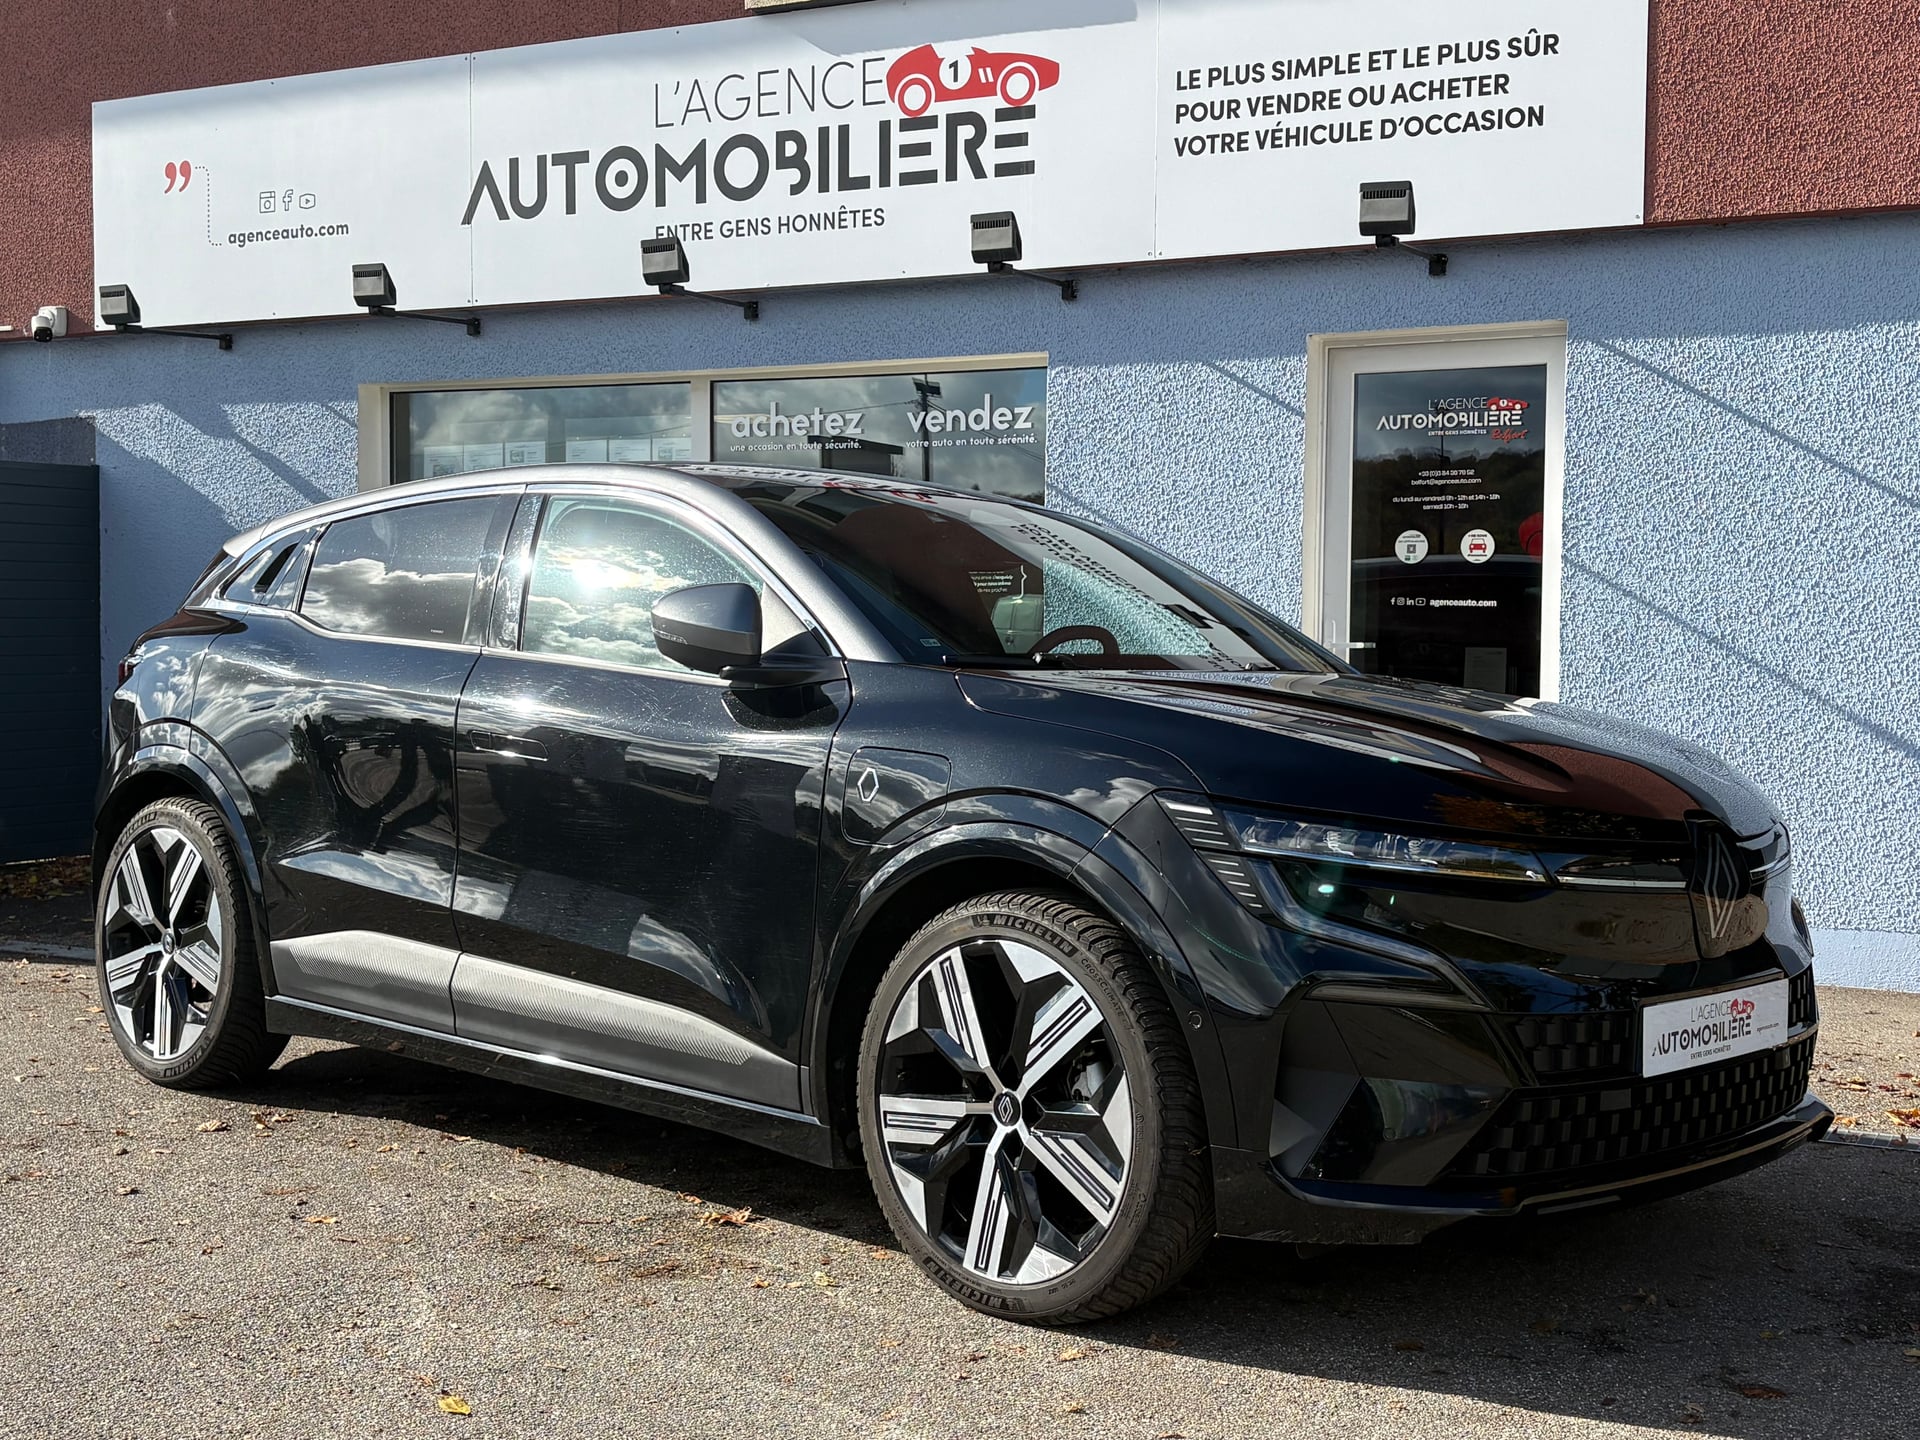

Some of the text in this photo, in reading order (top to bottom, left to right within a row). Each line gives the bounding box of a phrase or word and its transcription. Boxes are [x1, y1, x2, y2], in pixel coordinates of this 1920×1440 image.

[1175, 28, 1560, 91] LE PLUS SIMPLE ET LE PLUS SÛR
[654, 56, 886, 129] L'AGENCE
[1175, 73, 1510, 125] POUR VENDRE OU ACHETER
[1173, 104, 1545, 158] VOTRE VÉHICULE D'OCCASION
[228, 221, 349, 248] agenceauto.com
[655, 205, 885, 242] ENTRE GENS HONNÊTES
[731, 402, 864, 438] achetez
[906, 393, 1034, 433] vendez
[748, 441, 784, 452] occasion
[785, 442, 797, 451] en
[799, 440, 823, 450] toute
[825, 438, 862, 450] sécurité.
[906, 433, 1038, 448] votre auto en toute sérénité.
[1429, 599, 1497, 607] agenceauto.com
[993, 913, 1073, 955] MICHELIN
[1081, 957, 1124, 1017] CROSSCLIMATE
[926, 1258, 1006, 1309] MICHELIN
